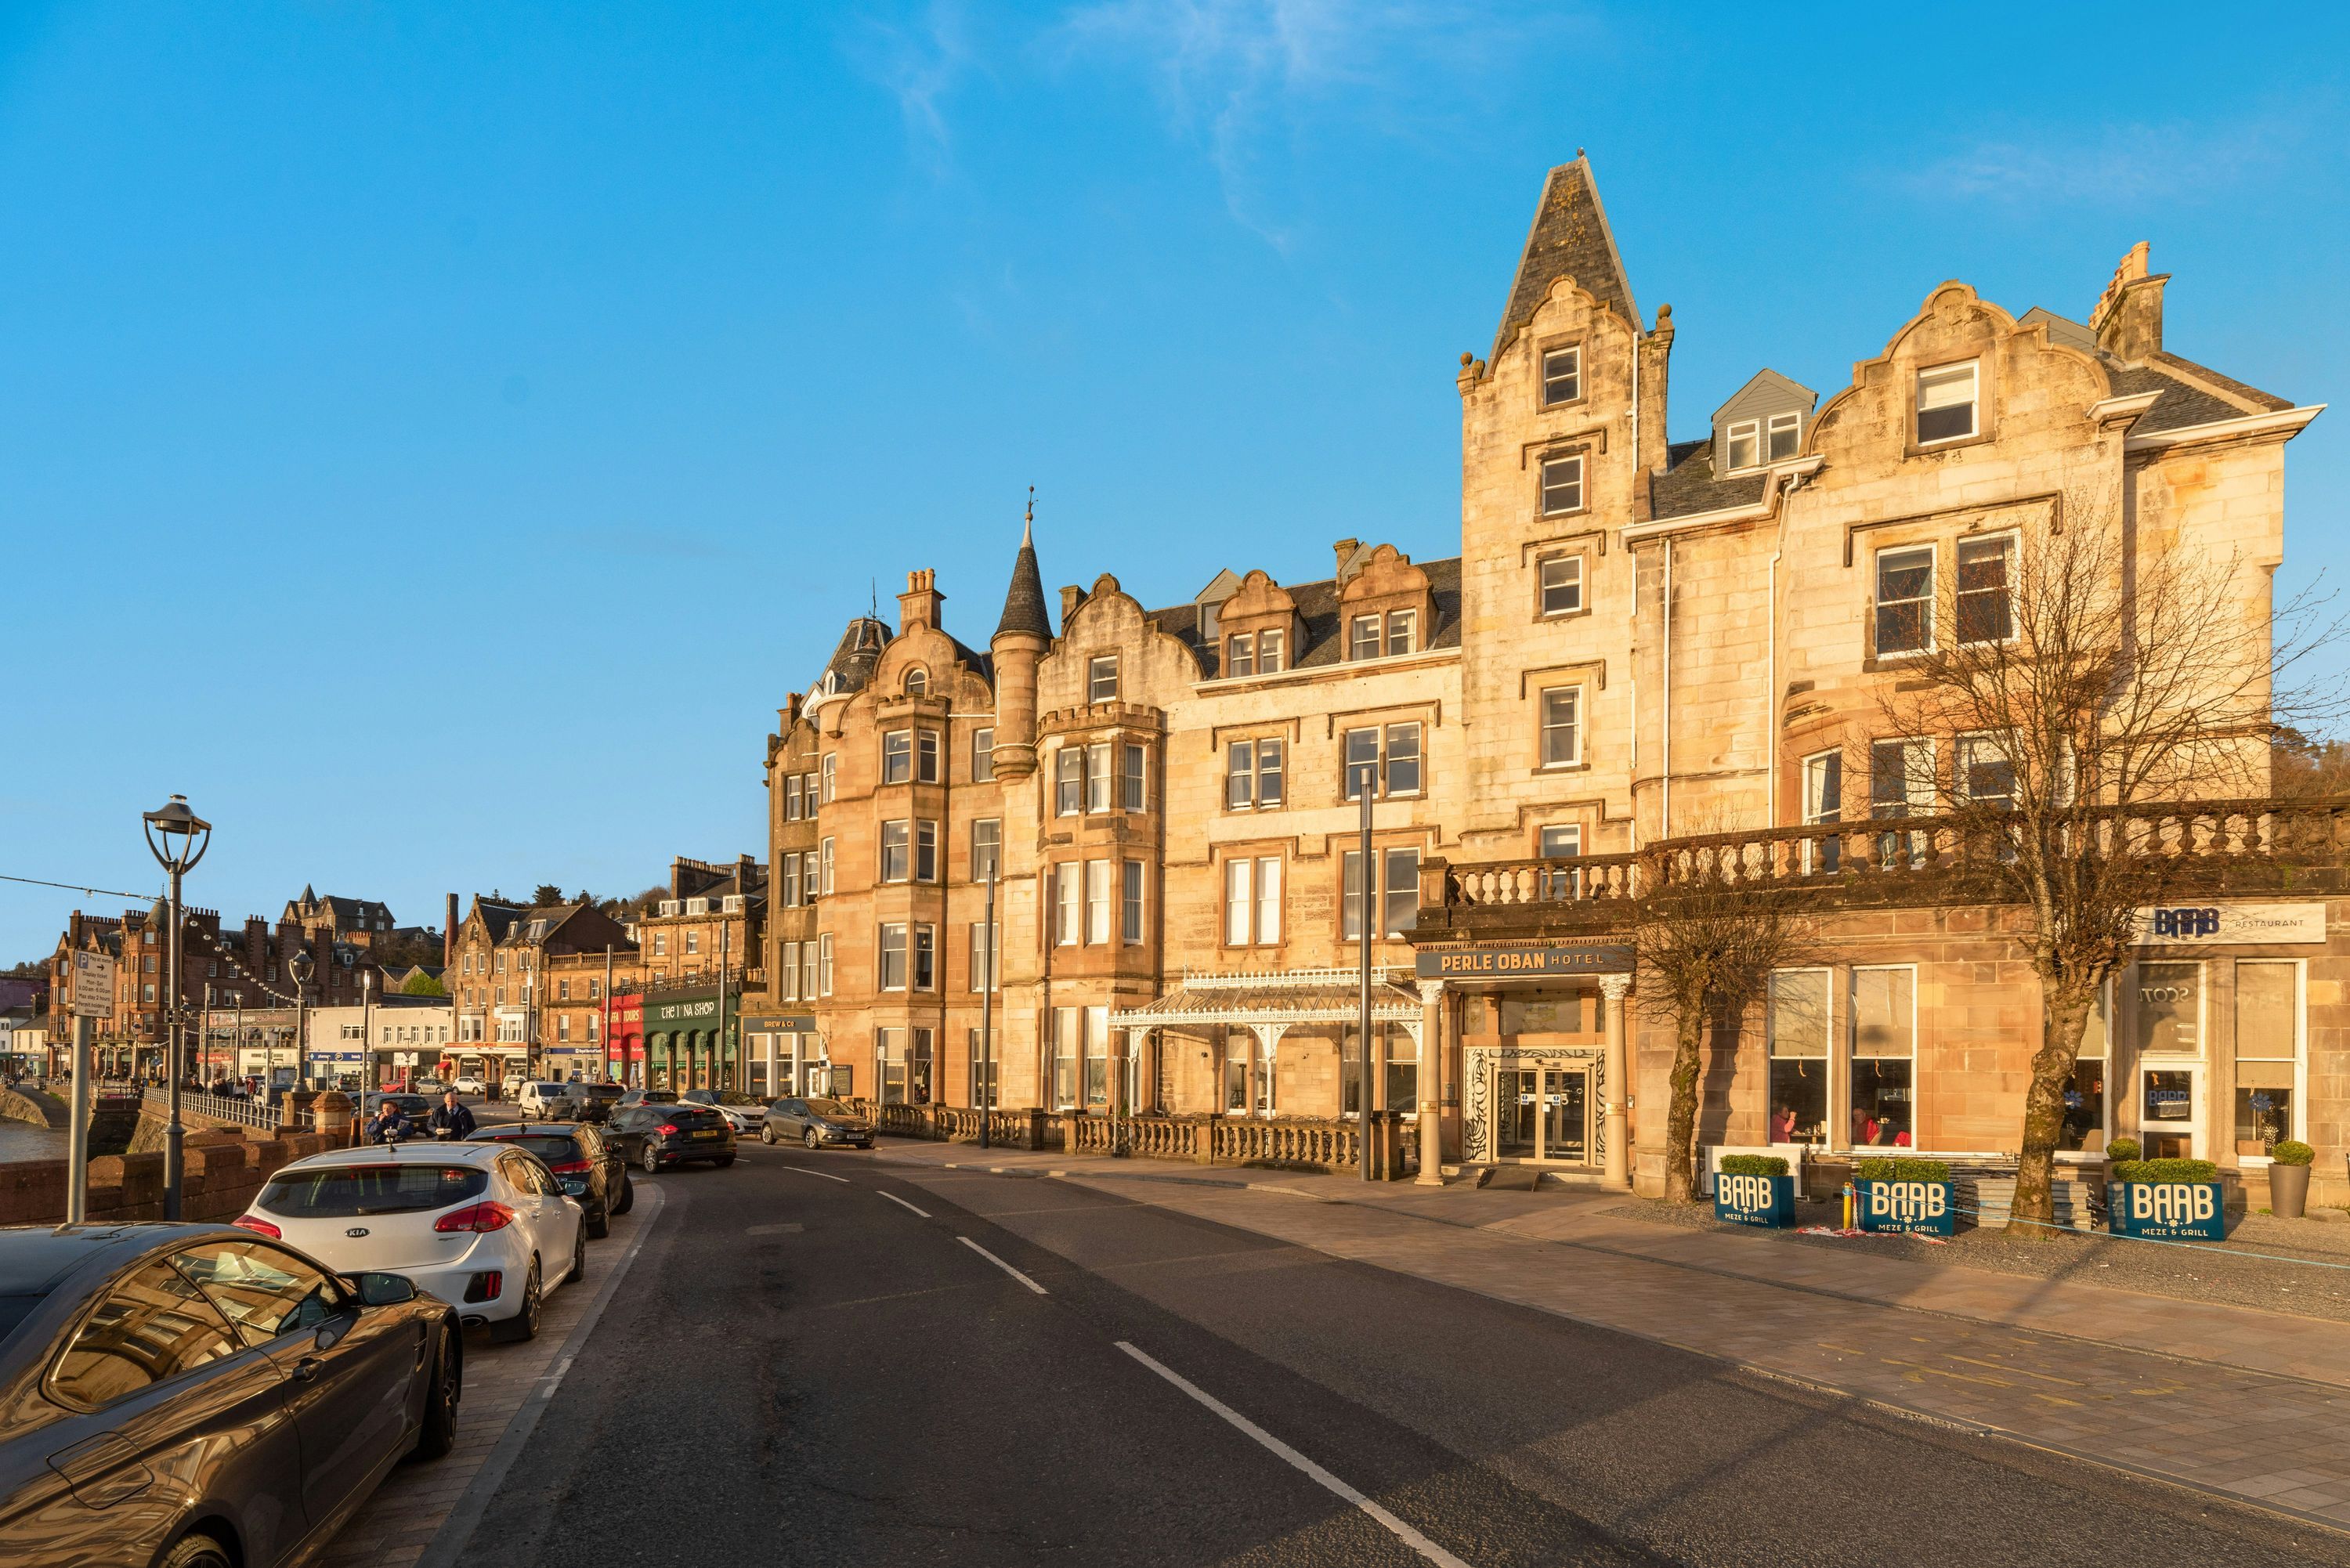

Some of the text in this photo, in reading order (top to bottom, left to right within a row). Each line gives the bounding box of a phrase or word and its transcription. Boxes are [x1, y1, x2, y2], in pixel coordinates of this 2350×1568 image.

[2155, 909, 2304, 938] BAAB RESTAURANT
[1441, 952, 1603, 971] PERLE OBAN HOTEL
[603, 1010, 639, 1023] SFFA TOURS
[695, 1002, 714, 1016] SHOP
[1719, 1175, 1772, 1212] BAAB
[1871, 1182, 1945, 1221] BAAB
[2133, 1184, 2214, 1224] BAAB
[1750, 1216, 1768, 1224] GRILL
